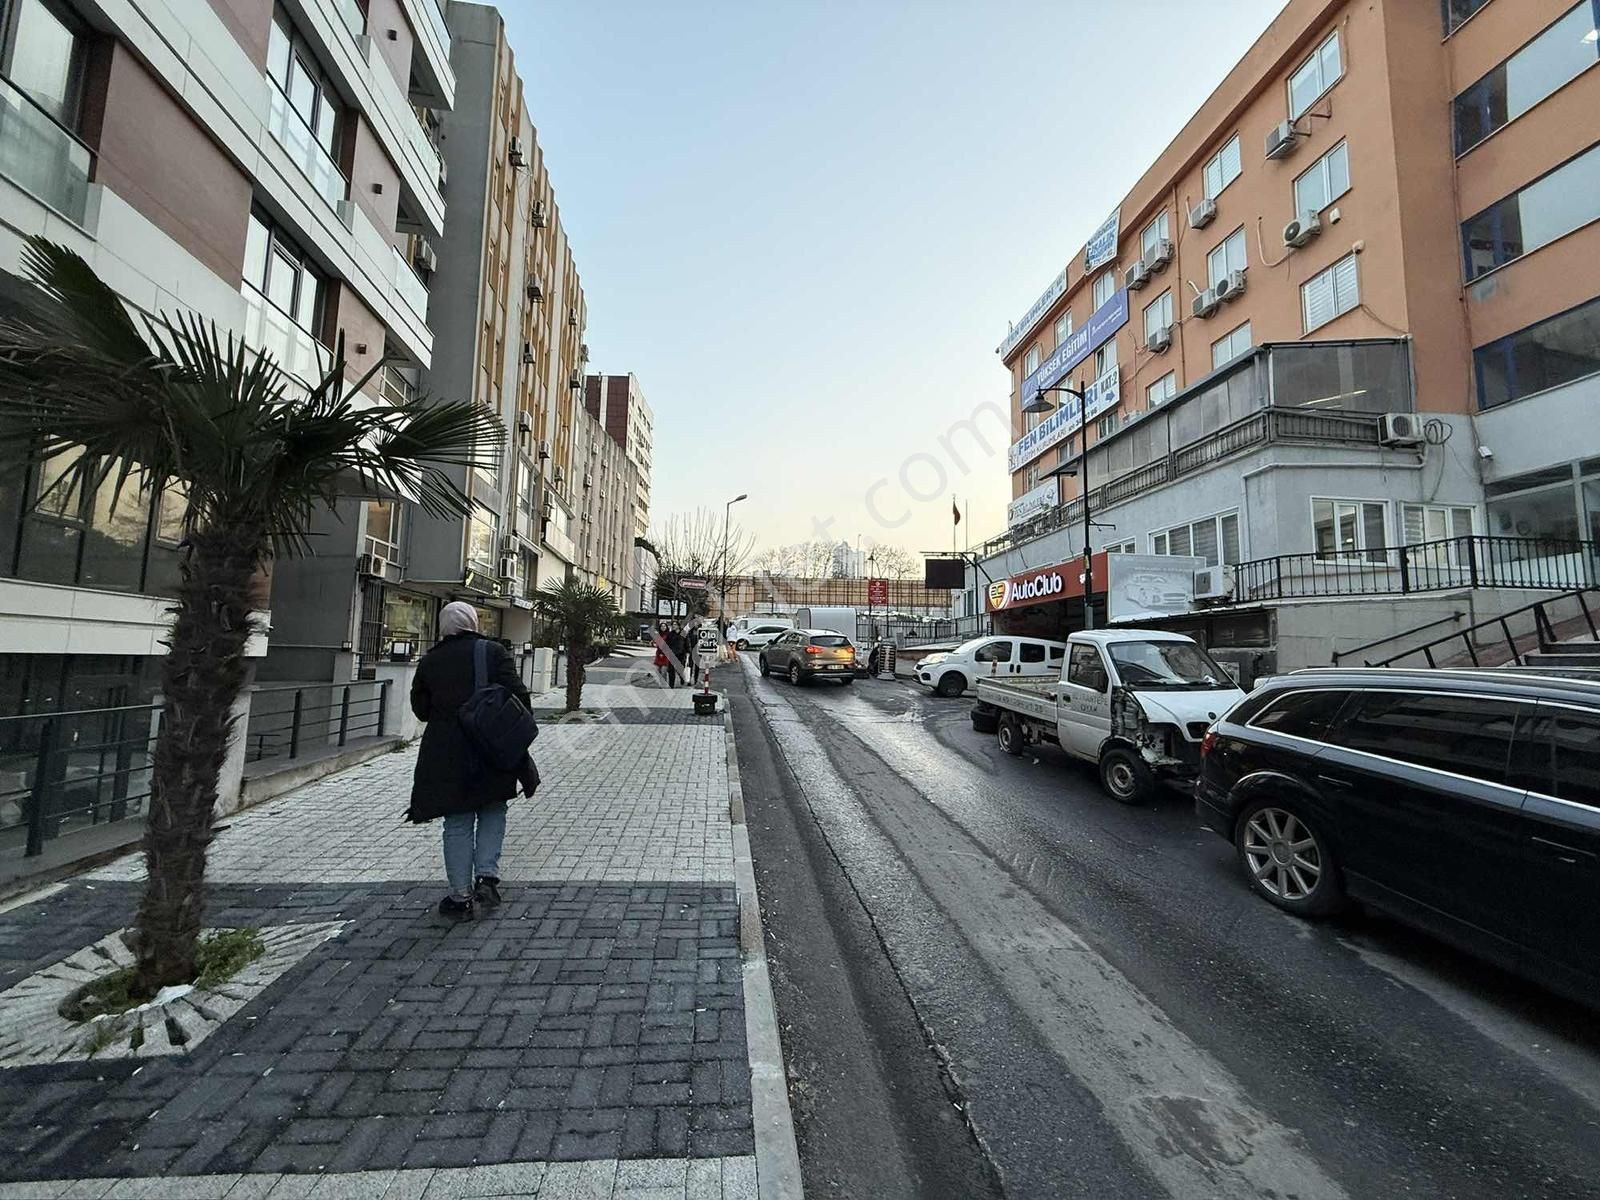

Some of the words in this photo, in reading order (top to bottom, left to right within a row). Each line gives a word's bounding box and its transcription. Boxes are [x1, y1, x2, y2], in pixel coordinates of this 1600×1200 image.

[1037, 357, 1062, 386] YÜKSEK
[1062, 329, 1088, 364] EĞİTİM
[1018, 431, 1037, 456] FEN
[1039, 383, 1098, 441] BİLİMLERİ
[1011, 572, 1063, 602] AutoClub
[698, 639, 718, 648] Park
[699, 630, 716, 639] Oto
